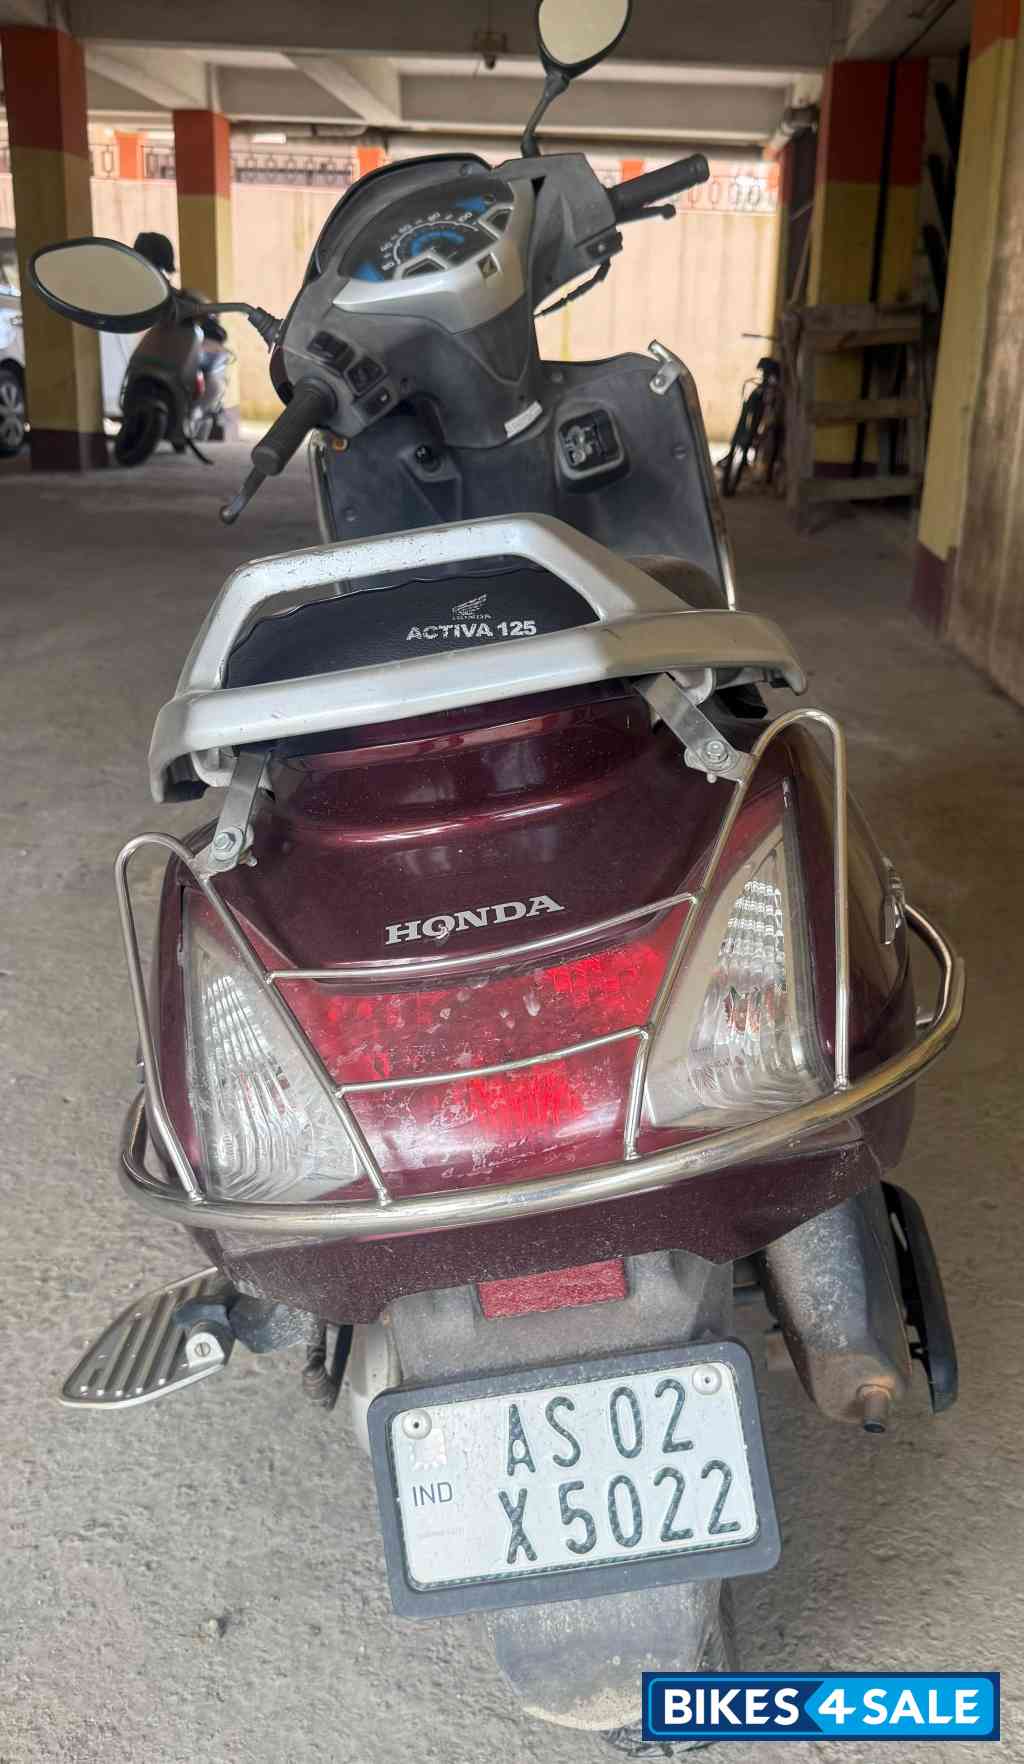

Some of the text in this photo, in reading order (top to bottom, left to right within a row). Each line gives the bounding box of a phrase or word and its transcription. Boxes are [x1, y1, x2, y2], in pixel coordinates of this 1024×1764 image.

[406, 620, 537, 641] ACTIVA 125
[385, 895, 564, 944] HONDA
[507, 1379, 693, 1475] AS 02
[412, 1481, 453, 1507] IND
